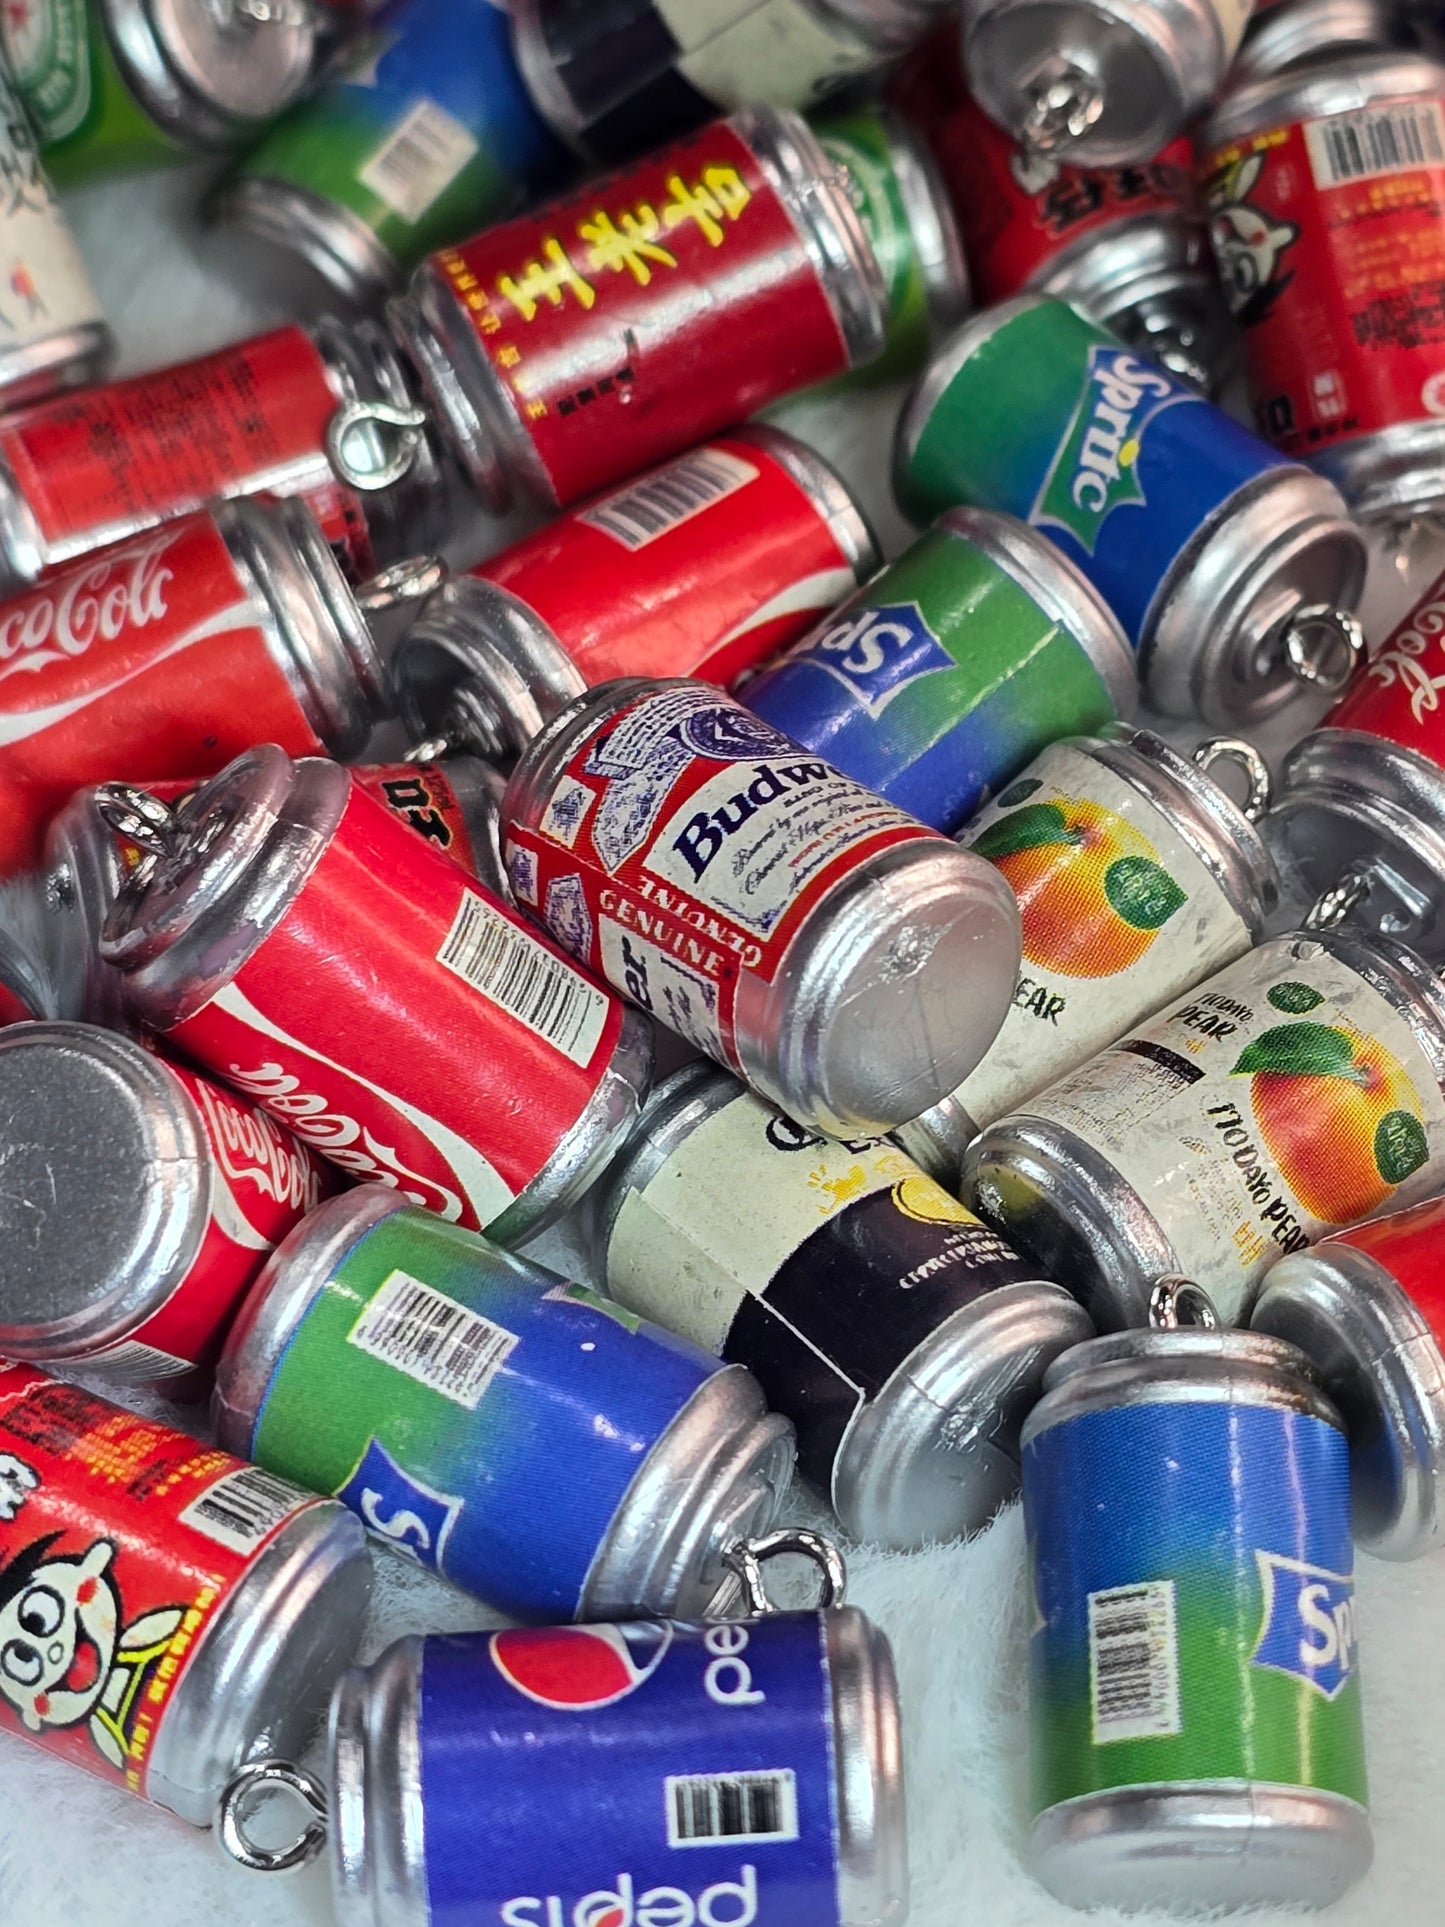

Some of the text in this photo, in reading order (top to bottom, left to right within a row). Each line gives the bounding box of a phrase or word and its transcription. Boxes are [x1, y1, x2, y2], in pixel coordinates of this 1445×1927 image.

[499, 166, 751, 322] 王老吉
[600, 889, 725, 977] GENUINE
[1165, 1005, 1238, 1043] PEAR
